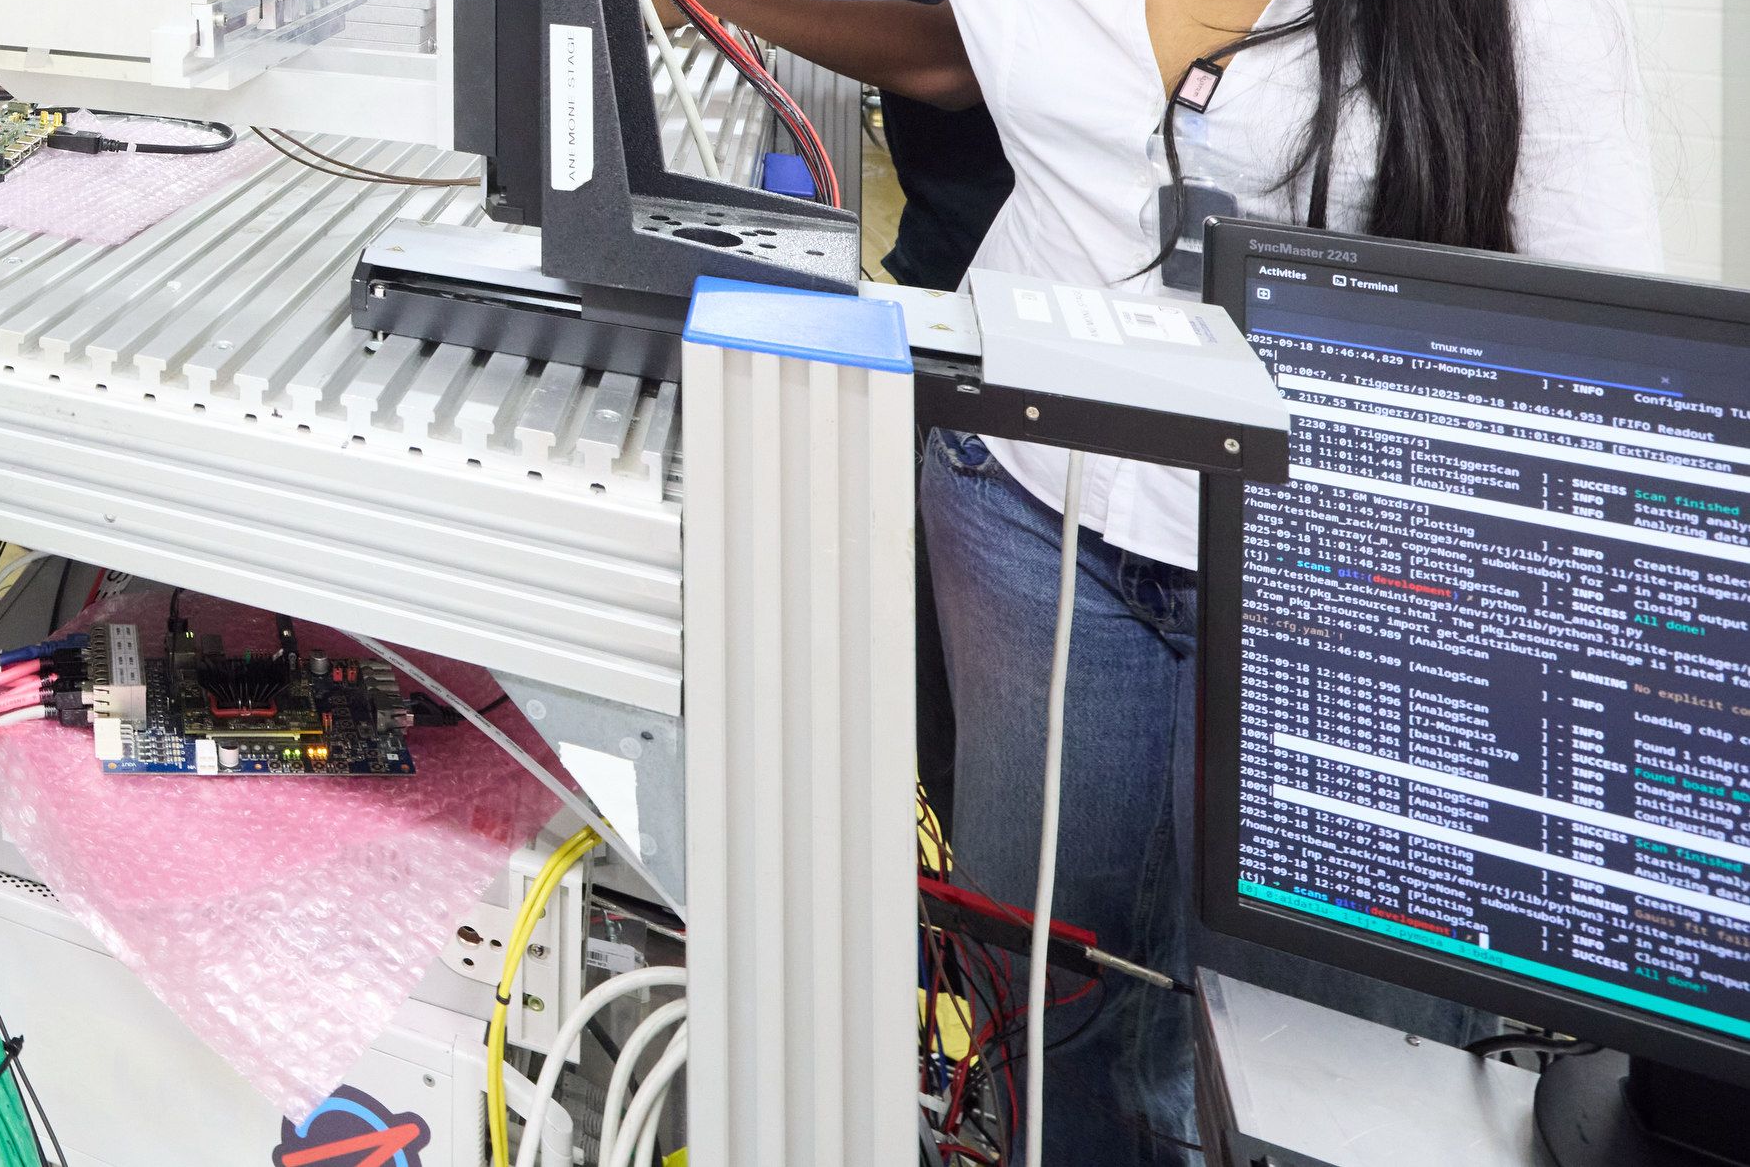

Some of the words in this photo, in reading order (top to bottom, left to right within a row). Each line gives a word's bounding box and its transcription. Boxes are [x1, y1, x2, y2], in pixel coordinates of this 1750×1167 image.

[567, 30, 576, 89] STAGE
[567, 95, 576, 181] ANEMONE
[1249, 239, 1324, 259] SyncMaster
[1327, 250, 1358, 264] 2243
[1259, 265, 1307, 281] Activities
[1350, 278, 1398, 294] Terminal
[1246, 334, 1313, 352] 2025-09-18
[1320, 345, 1403, 366] 10:46:44,829
[1411, 358, 1497, 380] [TJ-Monopix2
[1572, 383, 1603, 396] INFO
[1634, 392, 1722, 417] Configuring
[1430, 340, 1460, 354] tmux
[1459, 346, 1483, 357] new
[1298, 418, 1346, 434] 2230.38
[1353, 427, 1430, 450] Triggers/s]
[1299, 392, 1347, 408] 2117.55
[1512, 427, 1603, 451] 11:01:41,328
[1612, 443, 1731, 472] [ExtTriggerScan
[1512, 400, 1603, 424] 10:46:44,953
[1612, 416, 1650, 431] [FIFO
[1658, 423, 1714, 441] Readout
[1319, 434, 1402, 457] 11:01:41,429
[1411, 449, 1519, 477] [ExtTriggerScan
[1572, 477, 1627, 496] SUCCESS
[1635, 488, 1666, 503] Scan
[1674, 495, 1740, 515] finished
[1332, 488, 1367, 503] 15.6M
[1374, 495, 1429, 516] Words/s]
[1244, 484, 1311, 505] 2025-09-18
[1318, 498, 1402, 522] 11:01:45,992
[1410, 515, 1474, 538] [Plotting
[1572, 546, 1603, 560] INFO
[1635, 557, 1699, 581] Creating
[1707, 573, 1750, 589] selec
[1257, 514, 1284, 526] args
[1305, 521, 1393, 548] [np.array(_m,
[1402, 542, 1472, 564] copy=None,
[1482, 557, 1571, 583] subok=subok)
[1580, 574, 1603, 588] for
[1611, 584, 1627, 592] _m
[1635, 585, 1651, 597] in
[1659, 592, 1698, 608] args]
[1244, 547, 1269, 563] (tj)
[1297, 560, 1331, 574] scans
[1482, 598, 1527, 613] python
[1534, 608, 1643, 640] scan_analog.py
[1256, 588, 1283, 602] from
[1290, 597, 1380, 623] pkg_resources
[1387, 616, 1430, 634] import
[1242, 638, 1255, 648] ml
[1242, 598, 1310, 621] 2025-09-18
[1317, 614, 1401, 641] 12:46:05,989
[1410, 634, 1489, 660] [AnalogScan
[1572, 669, 1627, 690] WARNING
[1635, 682, 1651, 695] No
[1659, 690, 1725, 711] explicit
[1733, 706, 1750, 718] co
[1452, 616, 1474, 630] The
[1481, 624, 1580, 652] pkg_resources
[1588, 647, 1643, 666] package
[1651, 658, 1667, 670] is
[1675, 664, 1724, 682] slated
[1241, 675, 1309, 699] 2025-09-18
[1316, 692, 1401, 721] 12:46:06,032
[1409, 713, 1496, 743] [TJ-Monopix2
[1573, 752, 1628, 774] SUCCESS
[1636, 767, 1676, 785] Found
[1684, 778, 1725, 797] board
[1241, 688, 1309, 712] 2025-09-18
[1316, 705, 1401, 734] 12:46:06,160
[1409, 727, 1519, 762] [basil.HL.si570
[1573, 766, 1604, 782] INFO
[1636, 781, 1692, 803] Changed
[1242, 662, 1309, 686] 2025-09-18
[1316, 679, 1401, 707] 12:46:05,996
[1409, 700, 1489, 728] [AnalogScan
[1573, 738, 1604, 754] INFO
[1636, 753, 1733, 787] Initializing
[1241, 739, 1309, 765] 2025-09-18
[1315, 758, 1400, 788] 12:47:05,011
[1409, 781, 1488, 810] [AnalogScan
[1573, 822, 1628, 844] SUCCESS
[1636, 837, 1668, 855] Scan
[1676, 847, 1742, 873] finished
[1240, 804, 1308, 831] 2025-09-18
[1315, 824, 1400, 855] 12:47:07,904
[1408, 848, 1473, 877] [Plotting
[1573, 892, 1628, 916] WARNING
[1636, 908, 1677, 928] Gauss
[1685, 921, 1709, 937] fit
[1718, 930, 1750, 948] fail
[1240, 869, 1265, 887] (tj)
[1293, 886, 1328, 903] scans
[1239, 856, 1307, 883] 2025-09-18
[1314, 877, 1399, 909] 12:47:08,721
[1408, 902, 1488, 934] [AnalogScan
[1573, 948, 1628, 973] SUCCESS
[1636, 966, 1660, 982] All
[1669, 974, 1708, 995] done!
